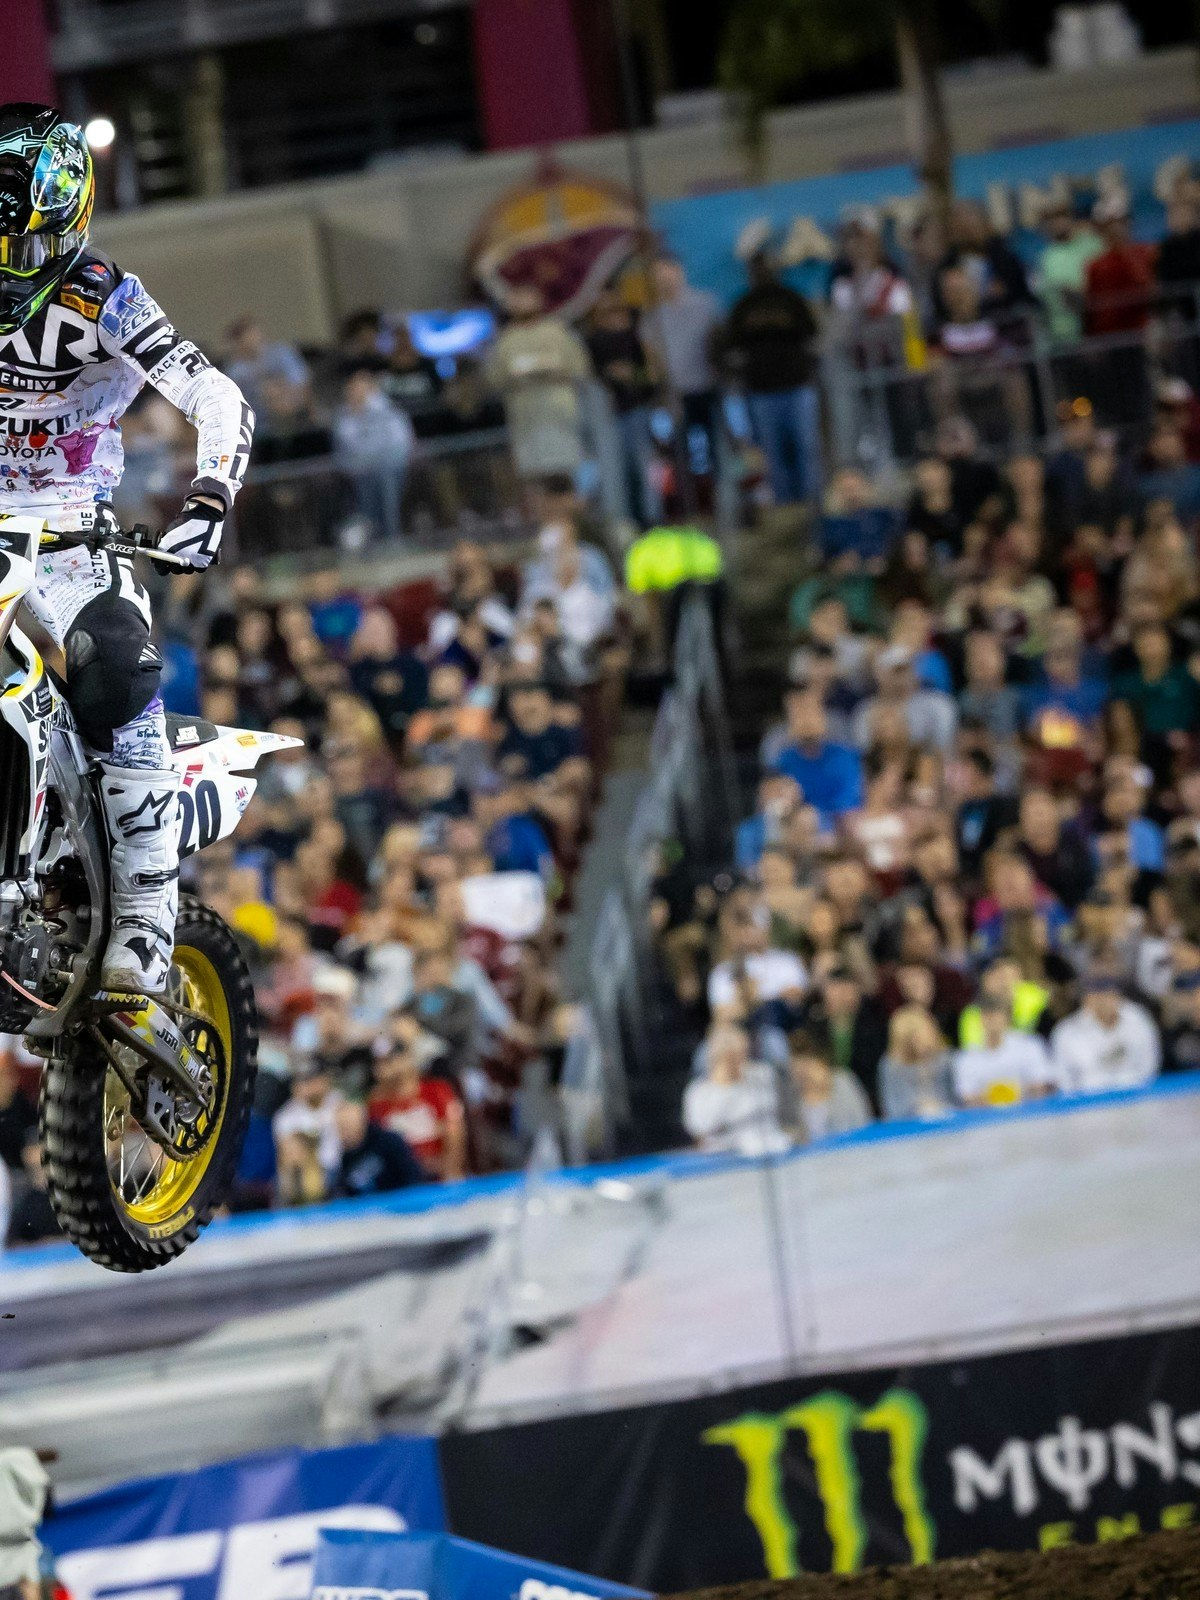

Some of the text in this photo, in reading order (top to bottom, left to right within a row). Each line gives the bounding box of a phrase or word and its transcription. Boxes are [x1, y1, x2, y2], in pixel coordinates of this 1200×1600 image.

[104, 543, 136, 555] ARC
[176, 779, 222, 860] 20
[156, 1027, 179, 1051] JGR
